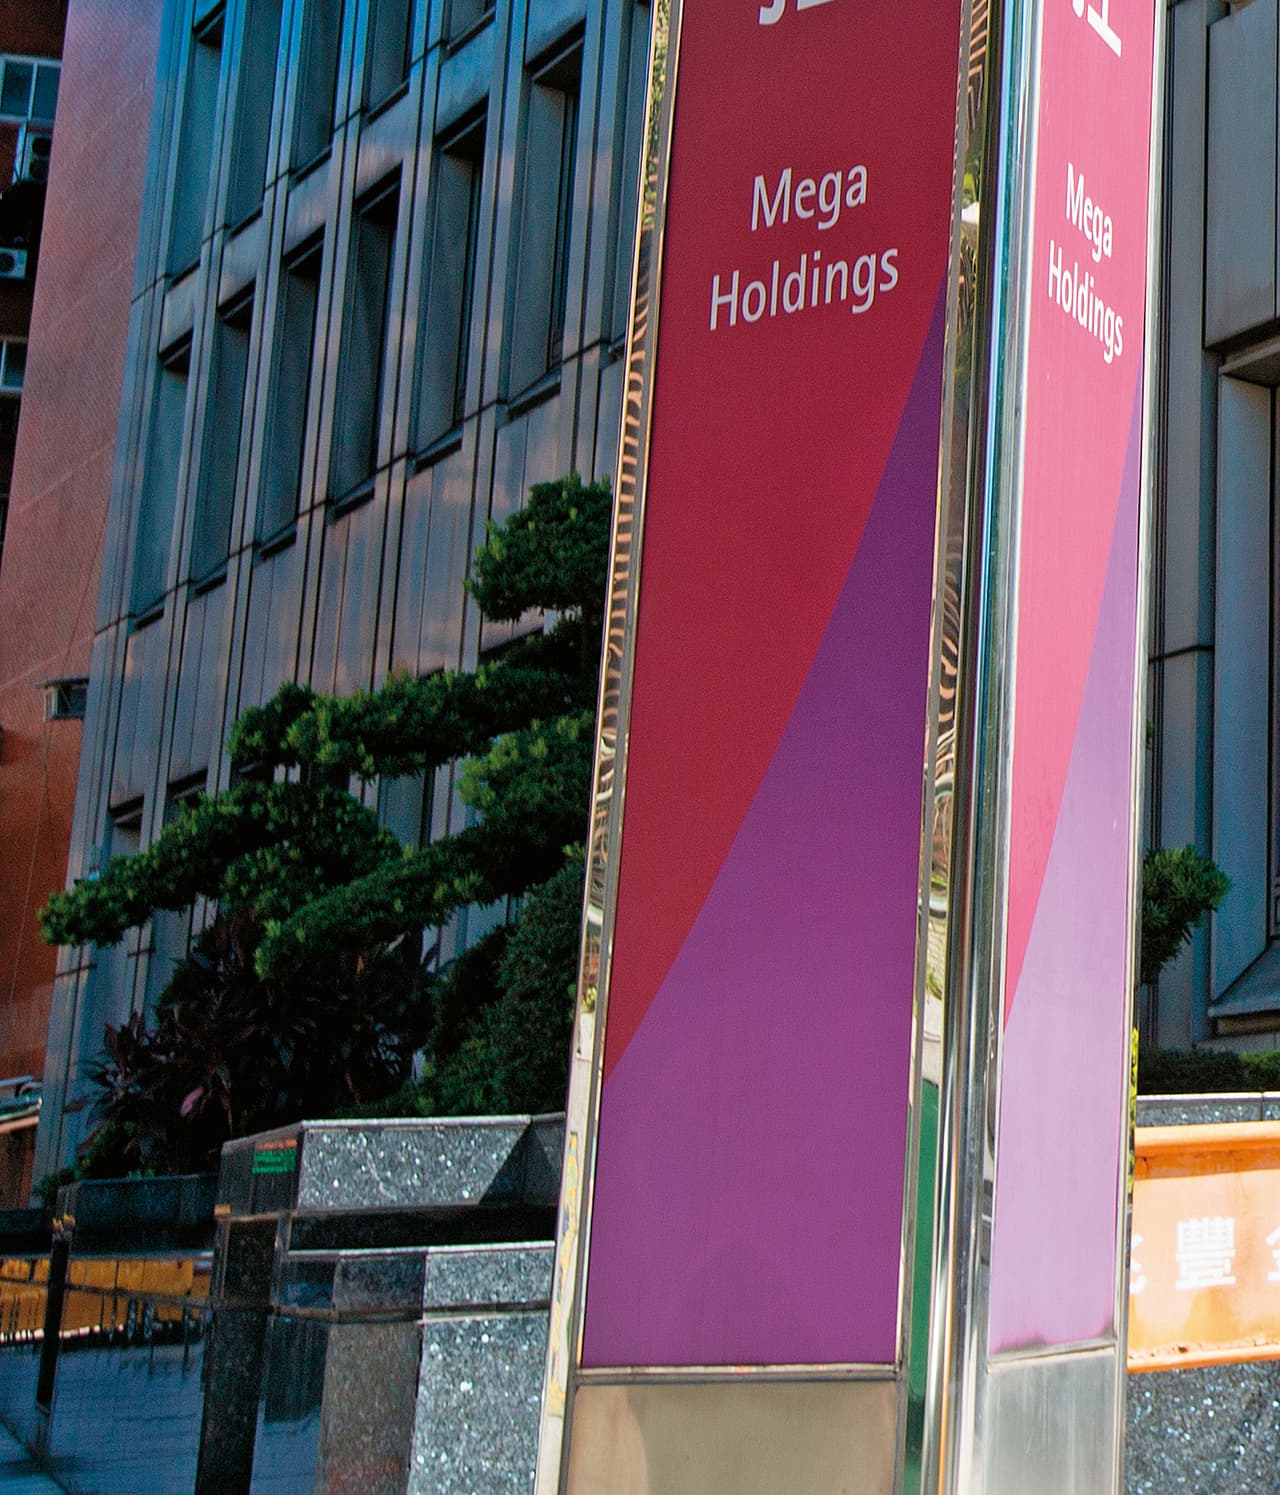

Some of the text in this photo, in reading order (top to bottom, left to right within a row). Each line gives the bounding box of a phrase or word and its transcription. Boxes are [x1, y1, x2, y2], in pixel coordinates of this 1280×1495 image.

[750, 161, 869, 233] Mega
[1065, 161, 1114, 257] Mega
[708, 247, 900, 332] Holdings
[1046, 240, 1125, 364] Holdings
